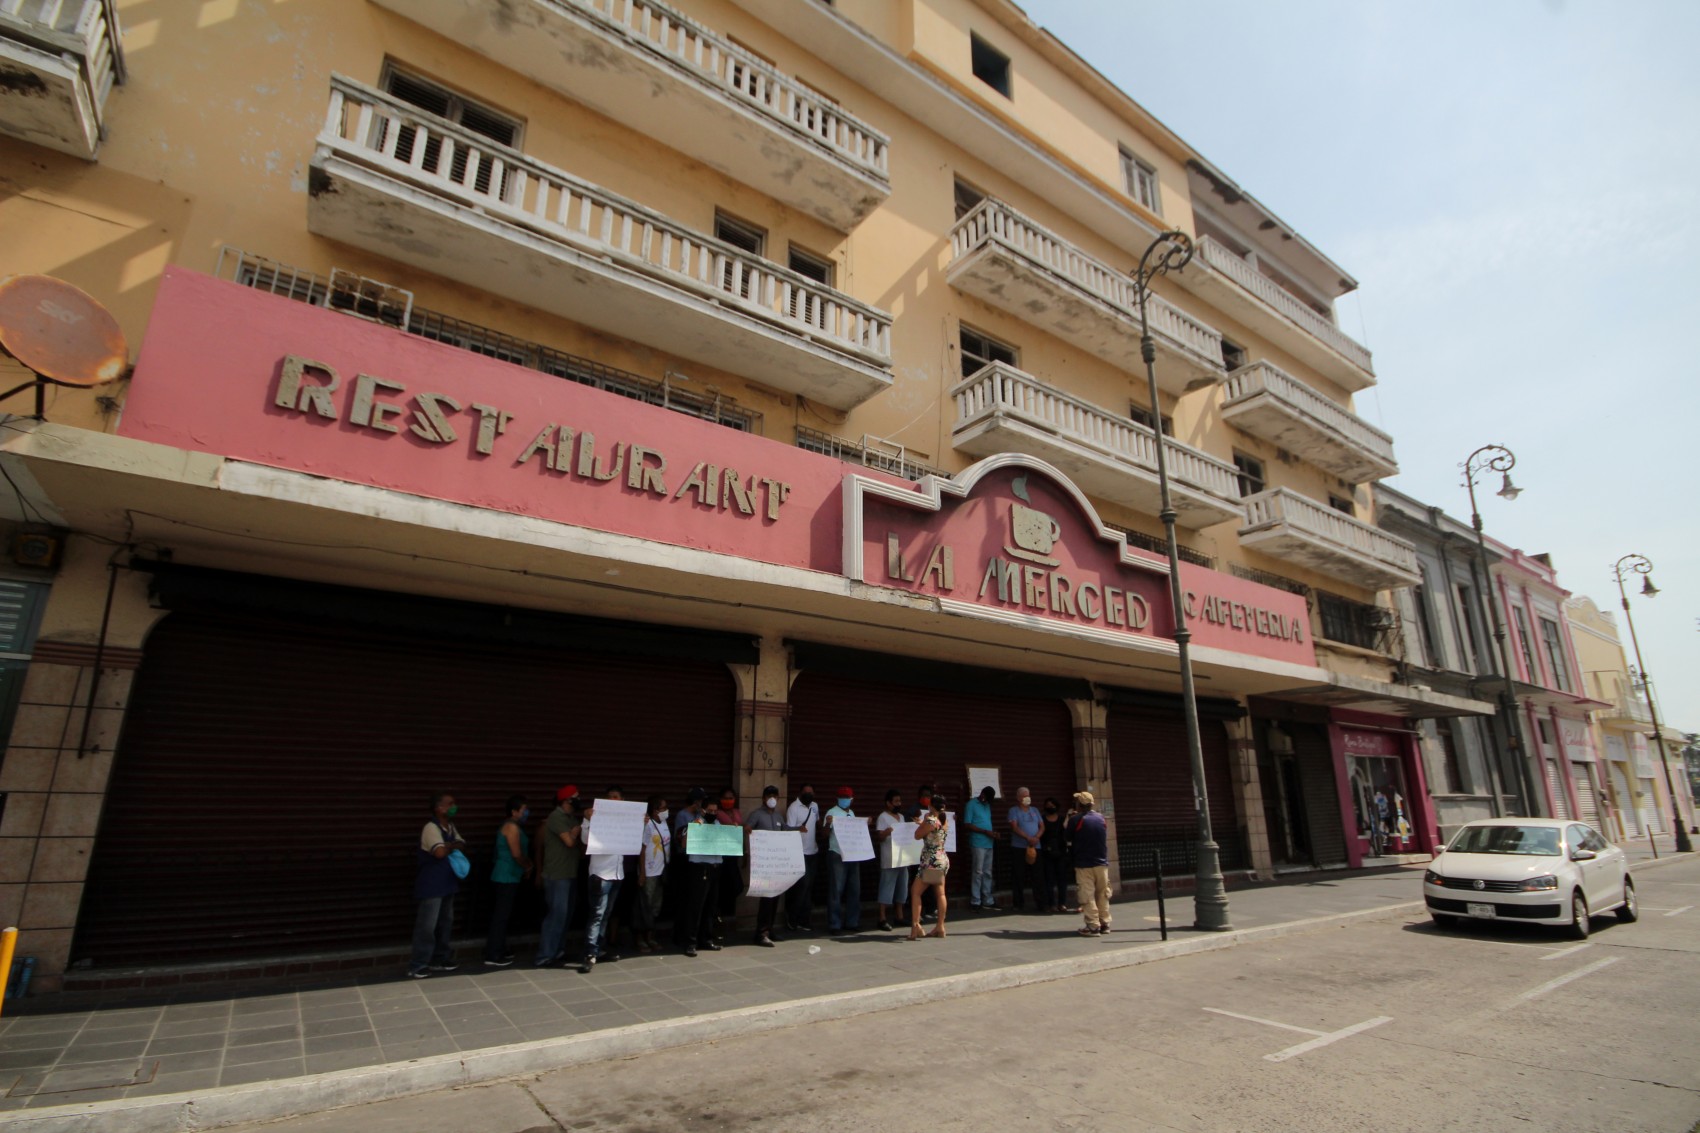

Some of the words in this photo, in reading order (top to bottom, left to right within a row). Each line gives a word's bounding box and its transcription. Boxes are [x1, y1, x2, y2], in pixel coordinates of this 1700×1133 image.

[274, 354, 792, 521] RESTAURANT
[888, 532, 955, 590] LA
[980, 556, 1149, 628] MERCED
[1182, 590, 1304, 643] CAFETERIA
[757, 742, 774, 768] 609
